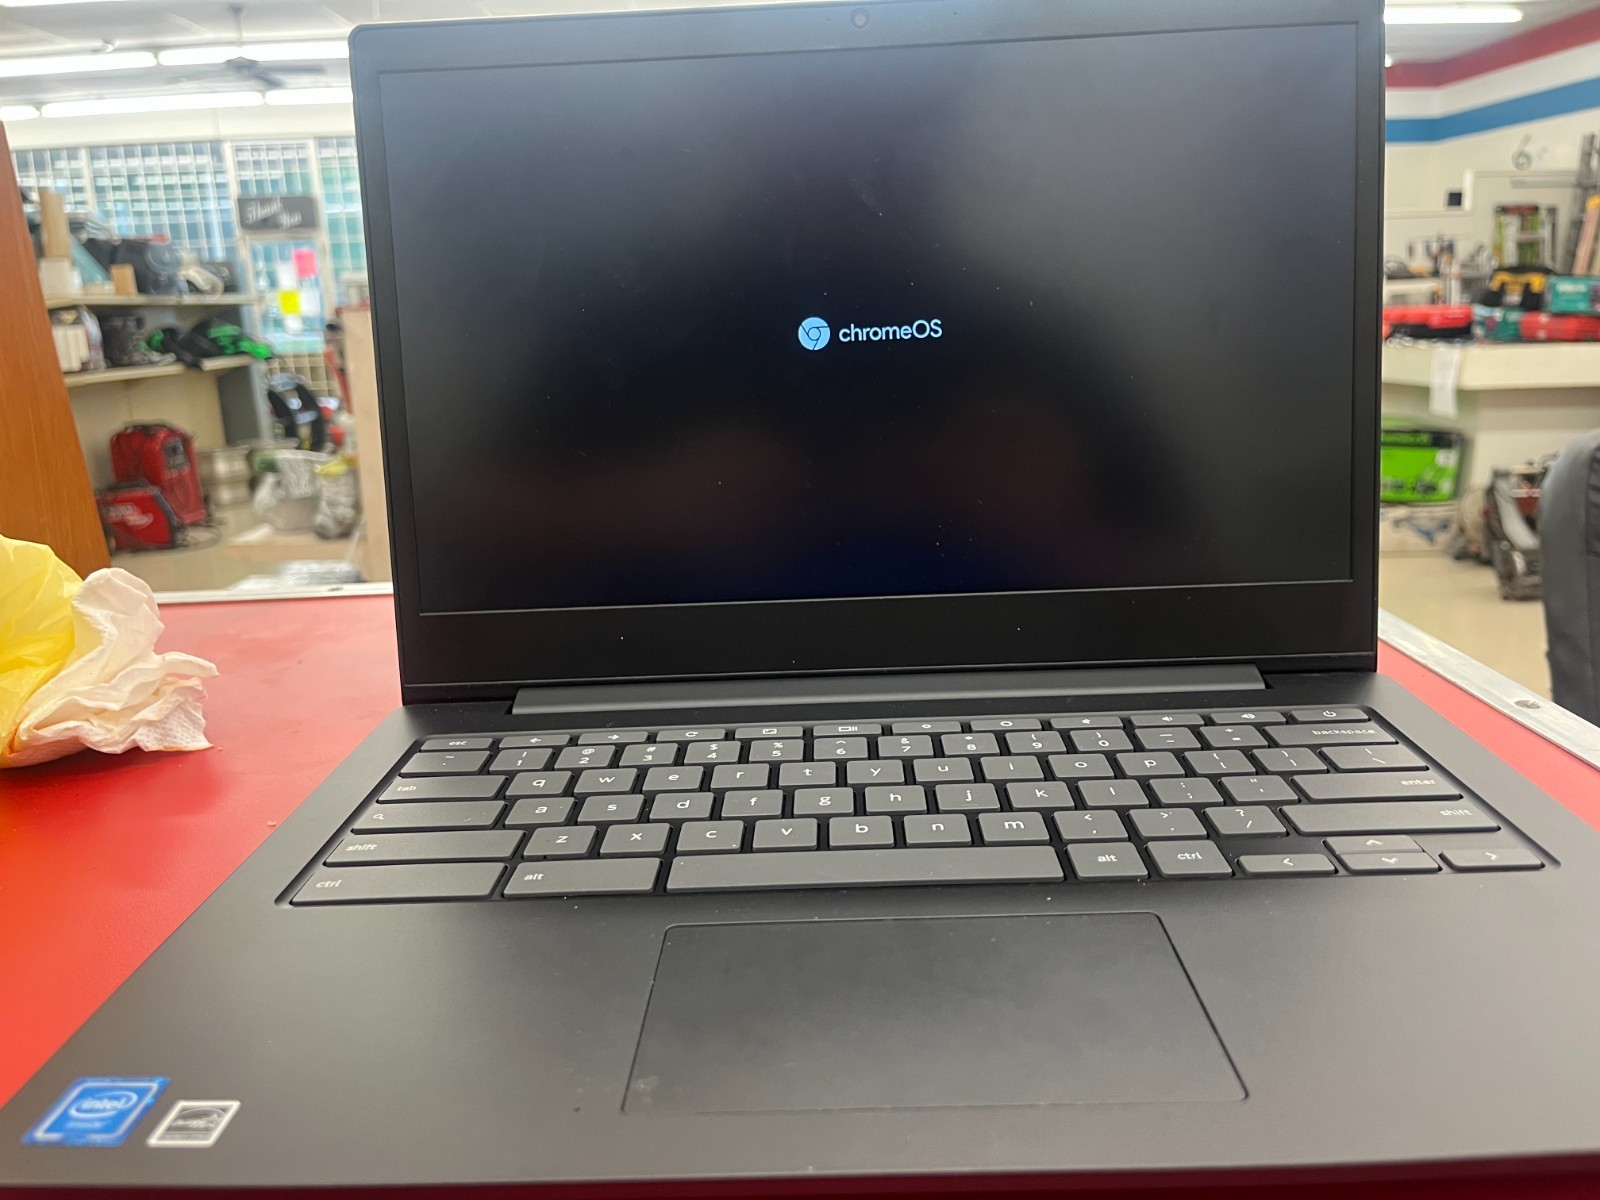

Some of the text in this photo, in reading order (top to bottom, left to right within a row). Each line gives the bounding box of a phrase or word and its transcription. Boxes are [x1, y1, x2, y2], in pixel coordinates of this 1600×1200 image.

[838, 318, 943, 343] chromeOS
[517, 759, 523, 767] 1
[1008, 762, 1015, 771] i
[1144, 759, 1157, 768] p
[736, 771, 745, 779] r
[803, 768, 813, 776] t
[870, 767, 882, 777] y
[599, 776, 616, 784] w
[668, 773, 680, 781] e
[532, 779, 546, 788] q
[890, 793, 902, 802] h
[965, 790, 972, 802] j
[1035, 789, 1048, 798] k
[676, 800, 690, 809] d
[750, 797, 758, 806] f
[819, 796, 831, 806] g
[534, 806, 548, 814] a
[855, 824, 869, 834] b
[932, 823, 945, 832] n
[1004, 820, 1025, 830] m
[630, 832, 643, 841] x
[706, 830, 718, 839] c
[781, 828, 793, 837] v
[555, 835, 569, 844] z
[345, 843, 378, 851] shift
[1097, 854, 1117, 863] alt
[1177, 851, 1203, 861] ctrl
[524, 873, 545, 881] alt
[315, 880, 343, 889] ctrl
[81, 1096, 128, 1110] intel
